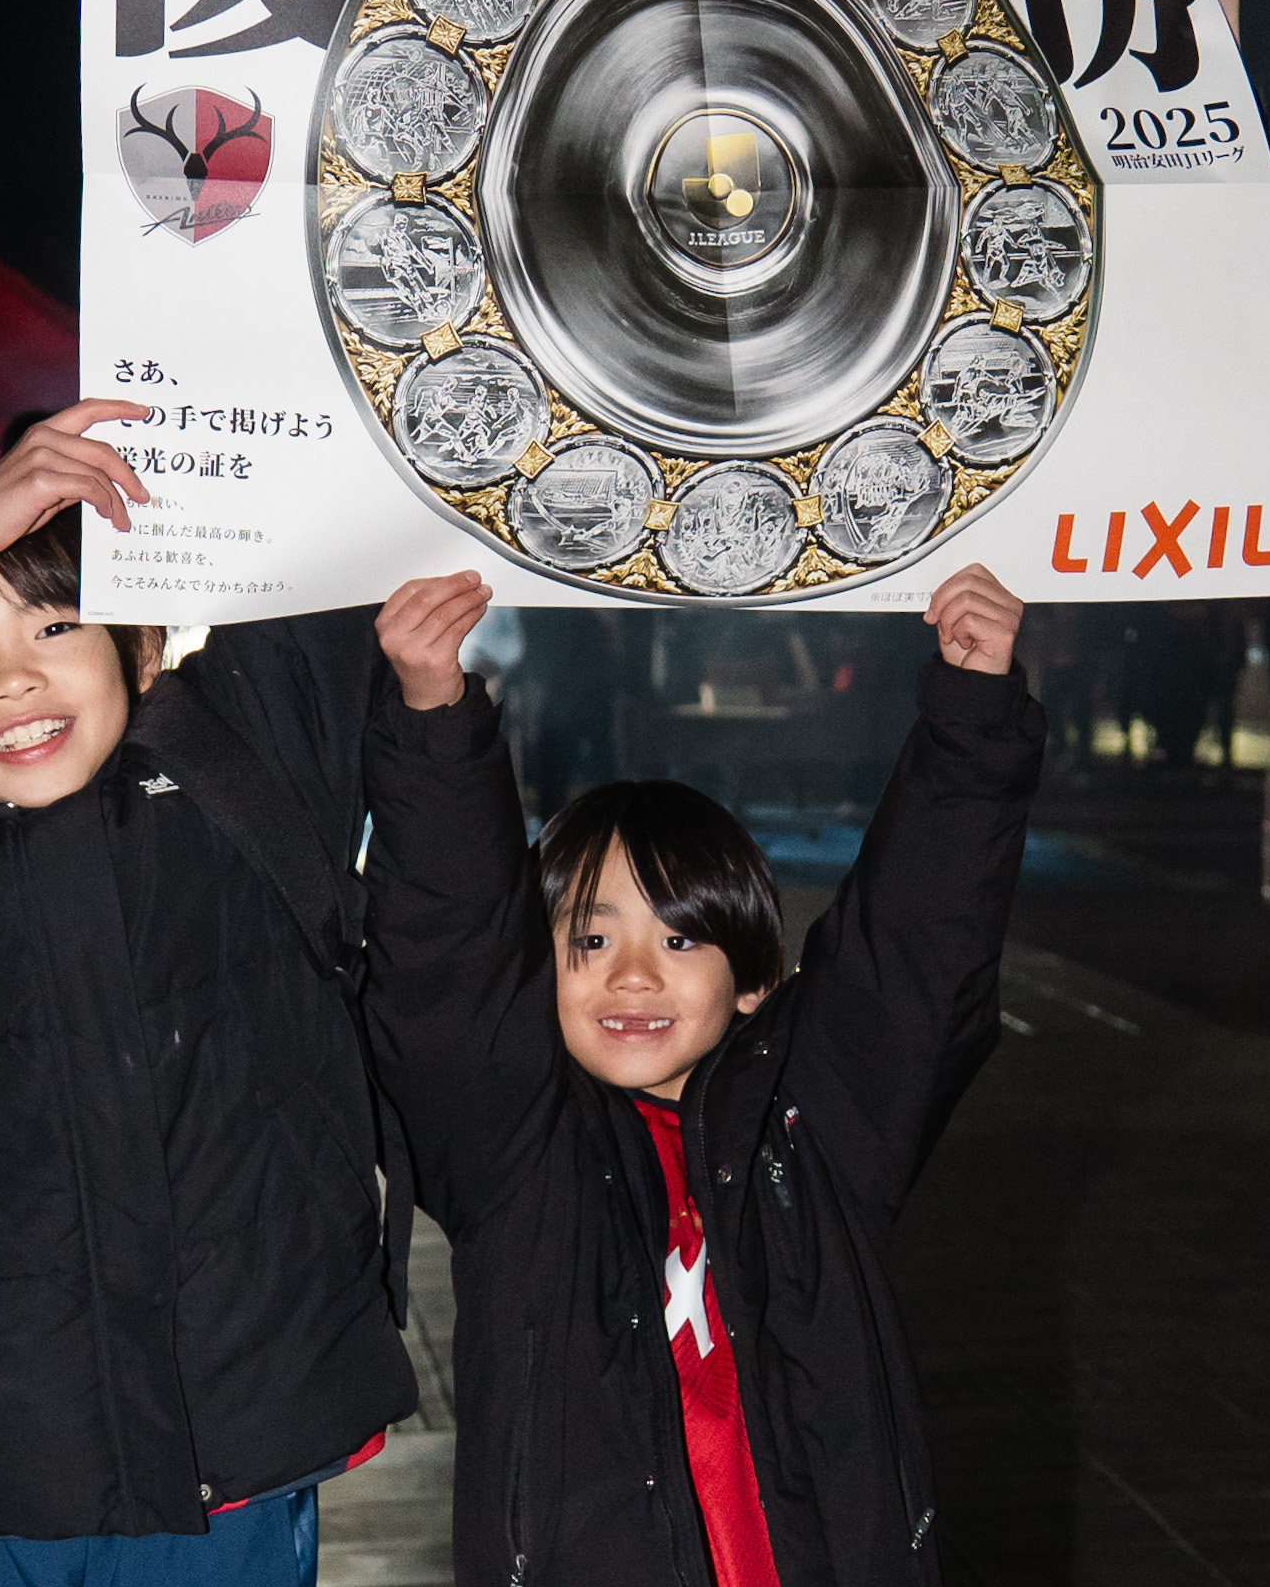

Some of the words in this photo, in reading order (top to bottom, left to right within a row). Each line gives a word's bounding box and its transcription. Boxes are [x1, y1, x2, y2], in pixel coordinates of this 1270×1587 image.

[1101, 101, 1239, 151] 2025
[1110, 146, 1245, 171] 明治安田J1リーグ
[688, 230, 765, 246] J.LEAGUE
[114, 359, 179, 386] さあ、
[116, 445, 253, 480] 栄光の証を
